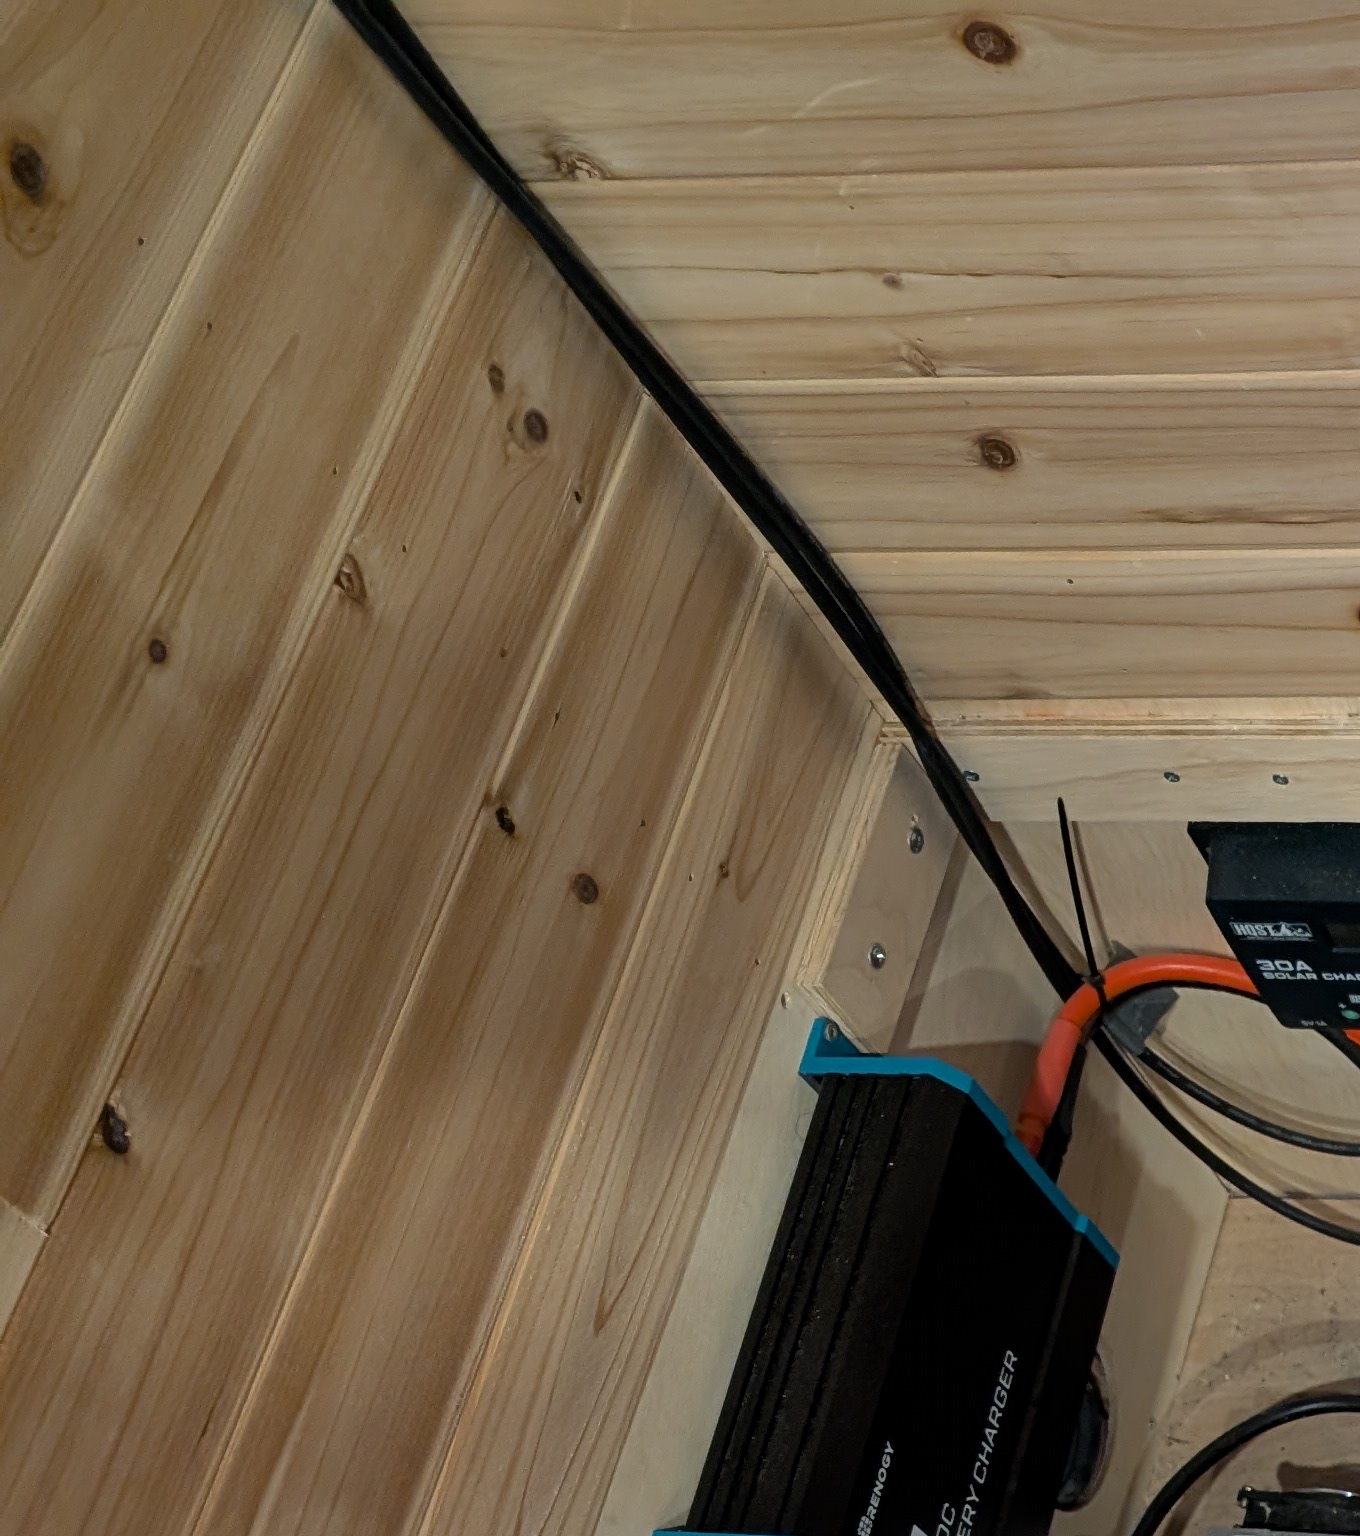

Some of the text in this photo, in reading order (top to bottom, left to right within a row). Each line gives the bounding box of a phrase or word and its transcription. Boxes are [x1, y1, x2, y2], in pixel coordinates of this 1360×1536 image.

[1256, 959, 1313, 972] 30A
[1263, 971, 1318, 981] SOLAR
[973, 1349, 1018, 1484] CHARGER
[866, 1440, 895, 1520] RENOGY
